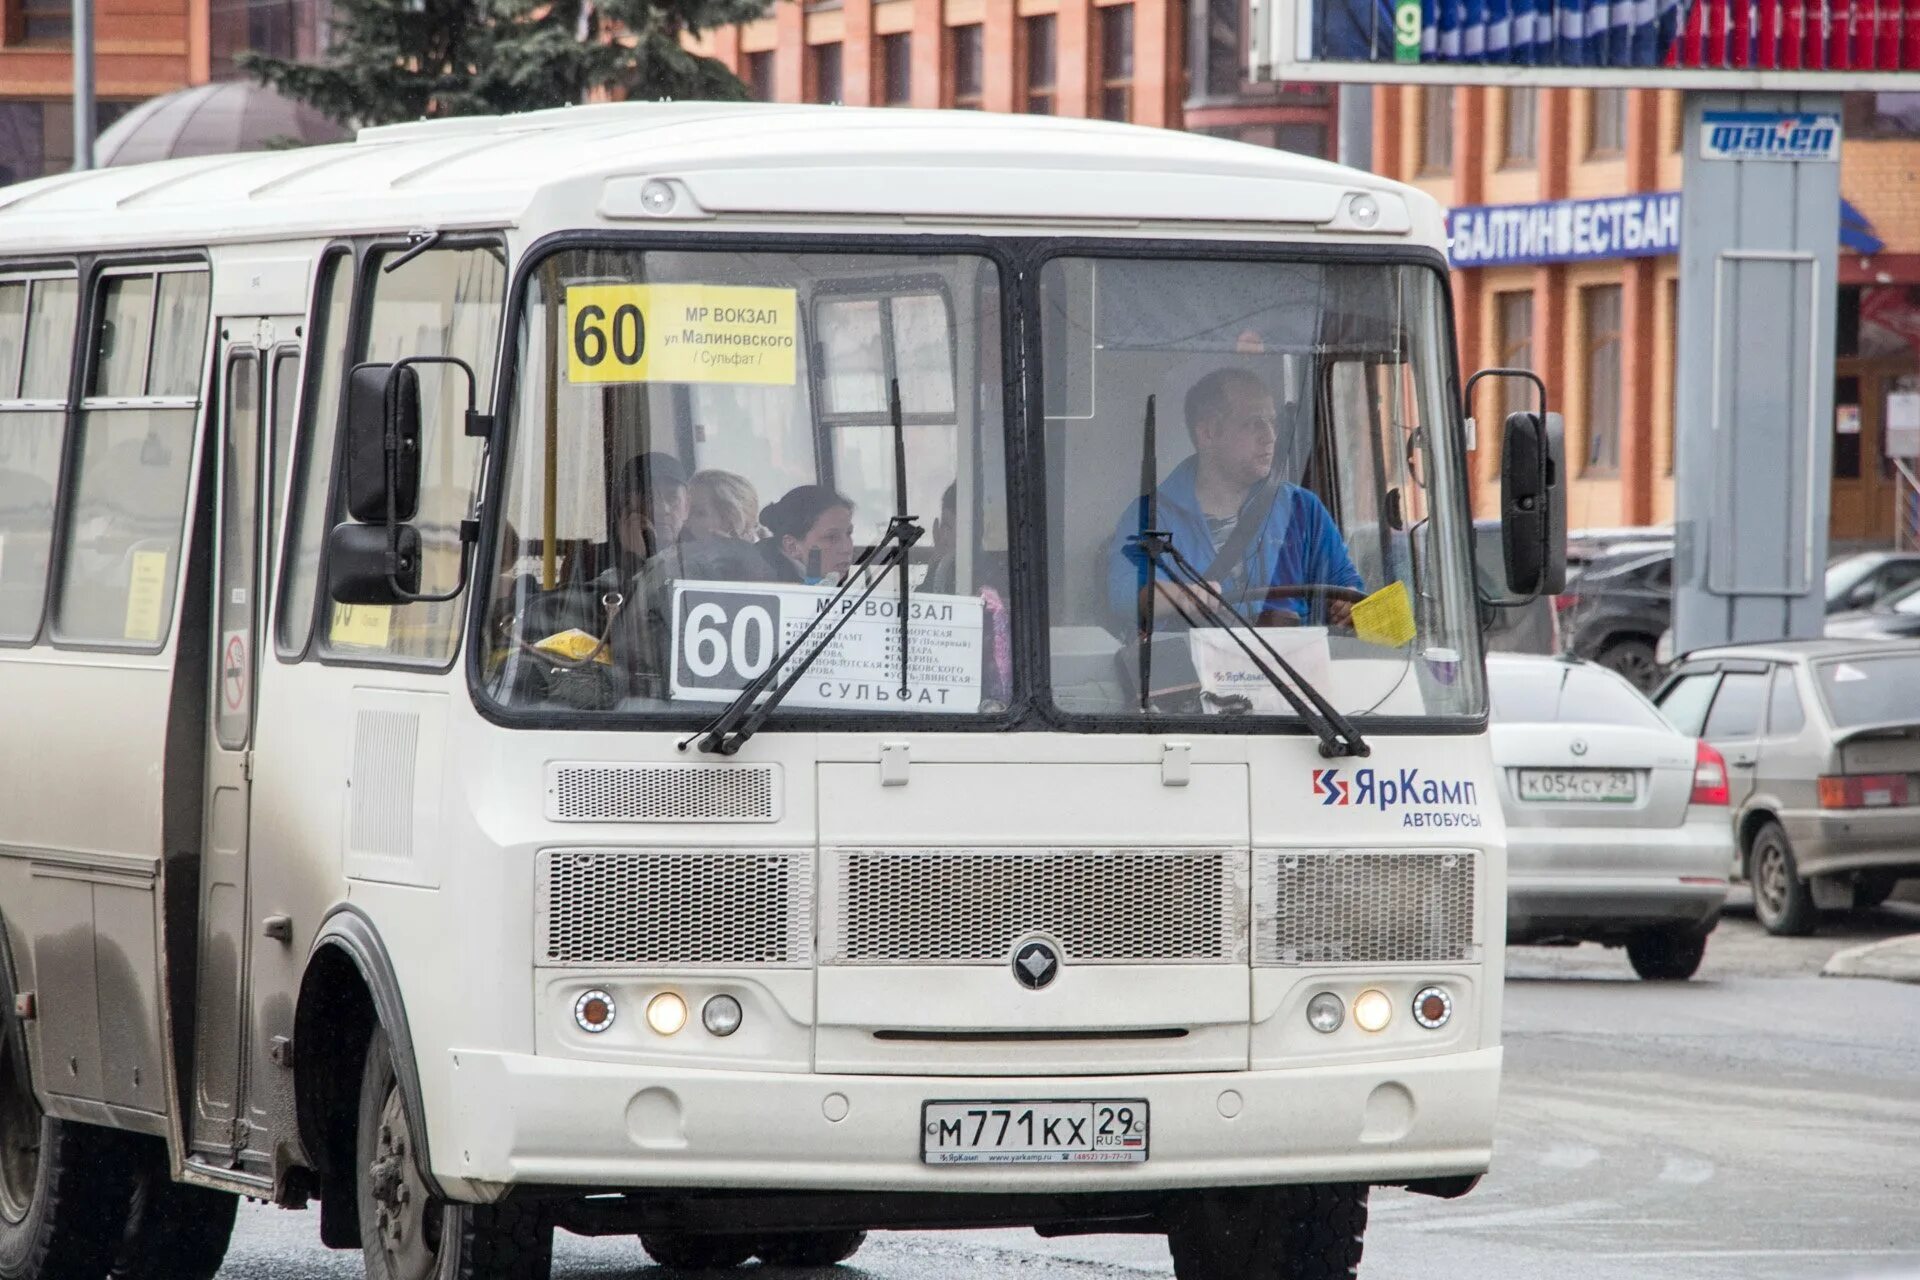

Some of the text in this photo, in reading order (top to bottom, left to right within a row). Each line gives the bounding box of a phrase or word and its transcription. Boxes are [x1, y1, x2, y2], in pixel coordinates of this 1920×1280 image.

[1453, 196, 1680, 261] БАЛТИНВЕСТБАН
[686, 307, 777, 324] МР ВОКЗАЛ
[574, 303, 645, 366] 60
[682, 329, 793, 347] Малиновского
[701, 350, 755, 366] Сульфат
[792, 621, 832, 631] АТРУМ
[684, 602, 774, 679] 60
[891, 645, 932, 655] ГАДАРА
[791, 657, 882, 669] КРНОФЛОТСКАЯ
[891, 654, 938, 664] ГААРИНА
[890, 671, 971, 684] УСЬ-ДВИНСКАЯ
[819, 682, 950, 705] СУЛЬФАТ
[1609, 773, 1628, 790] 29
[1355, 768, 1477, 812] ЯрКамп
[1403, 812, 1481, 828] АВТОБУСЫ
[939, 1107, 1134, 1147] М771КХ 29
[1096, 1135, 1122, 1146] RUS
[988, 1153, 1052, 1163] www.yarkamp.ru
